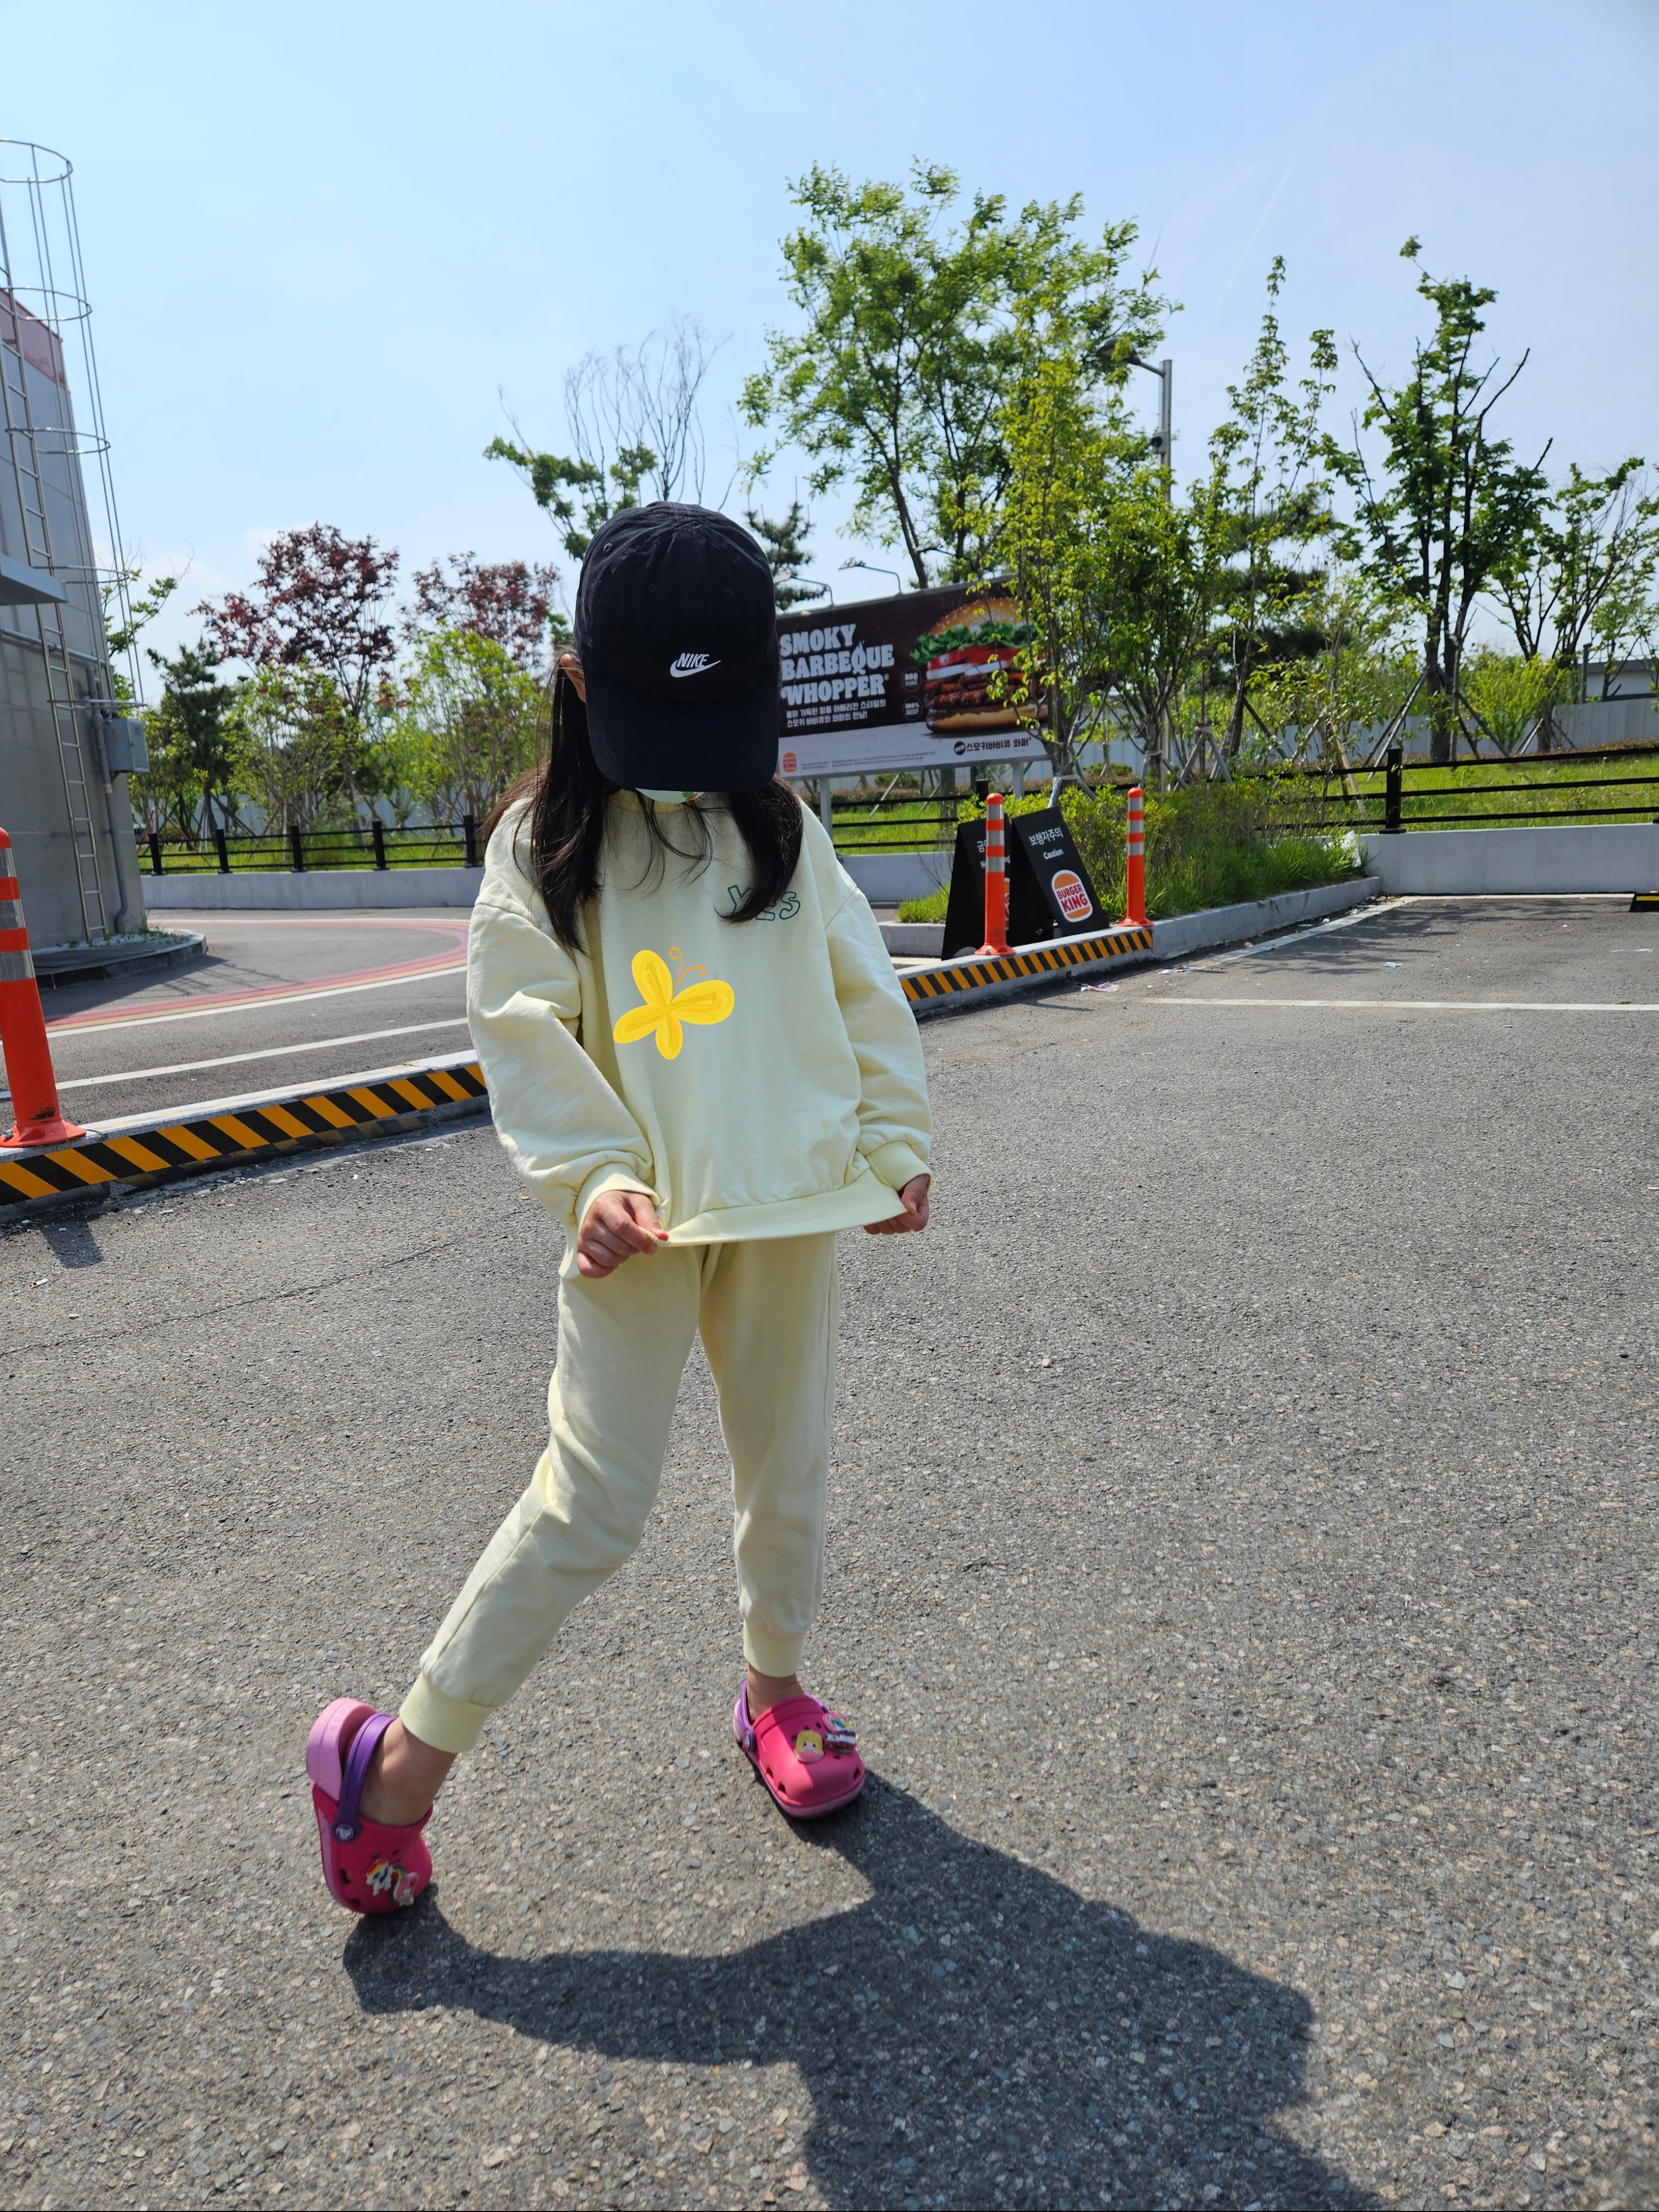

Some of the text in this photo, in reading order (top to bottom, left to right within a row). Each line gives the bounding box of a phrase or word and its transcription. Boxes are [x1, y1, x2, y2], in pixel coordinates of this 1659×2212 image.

[779, 623, 857, 656] SMOKY
[676, 653, 709, 667] NIKE
[781, 640, 895, 681] BARBEQUE
[905, 672, 919, 680] BBQ
[860, 698, 886, 709] 스타일의
[787, 718, 805, 728] 스모키
[966, 739, 1011, 752] 스모키바비큐
[1029, 826, 1064, 846] 보행자주의
[1043, 848, 1064, 859] Caution
[1057, 884, 1083, 900] BURGER
[1061, 893, 1088, 912] KING
